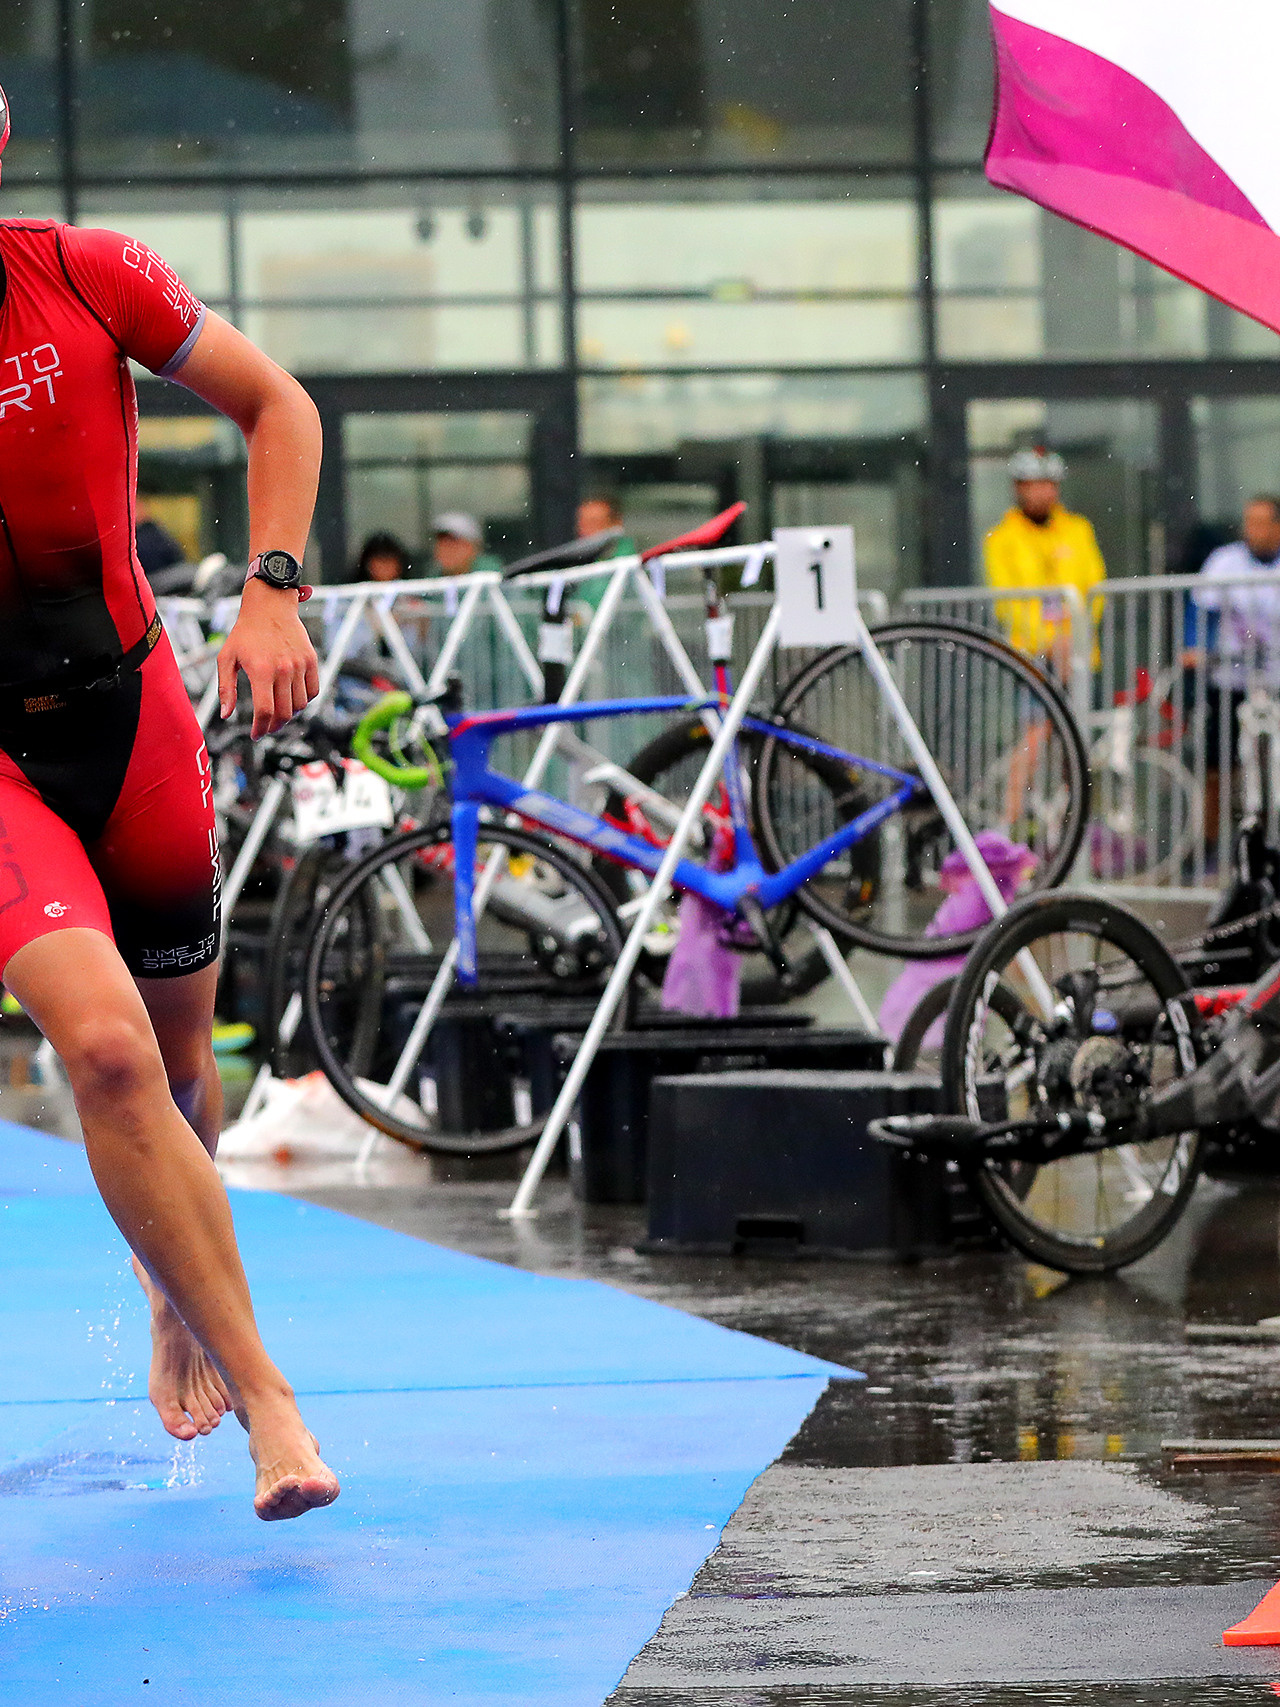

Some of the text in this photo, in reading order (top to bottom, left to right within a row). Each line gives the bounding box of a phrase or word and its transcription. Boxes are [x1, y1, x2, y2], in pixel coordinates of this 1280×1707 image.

[4, 342, 61, 381] TO
[809, 564, 823, 610] 1
[140, 932, 216, 959] TIME TO
[142, 941, 216, 969] SPORT
